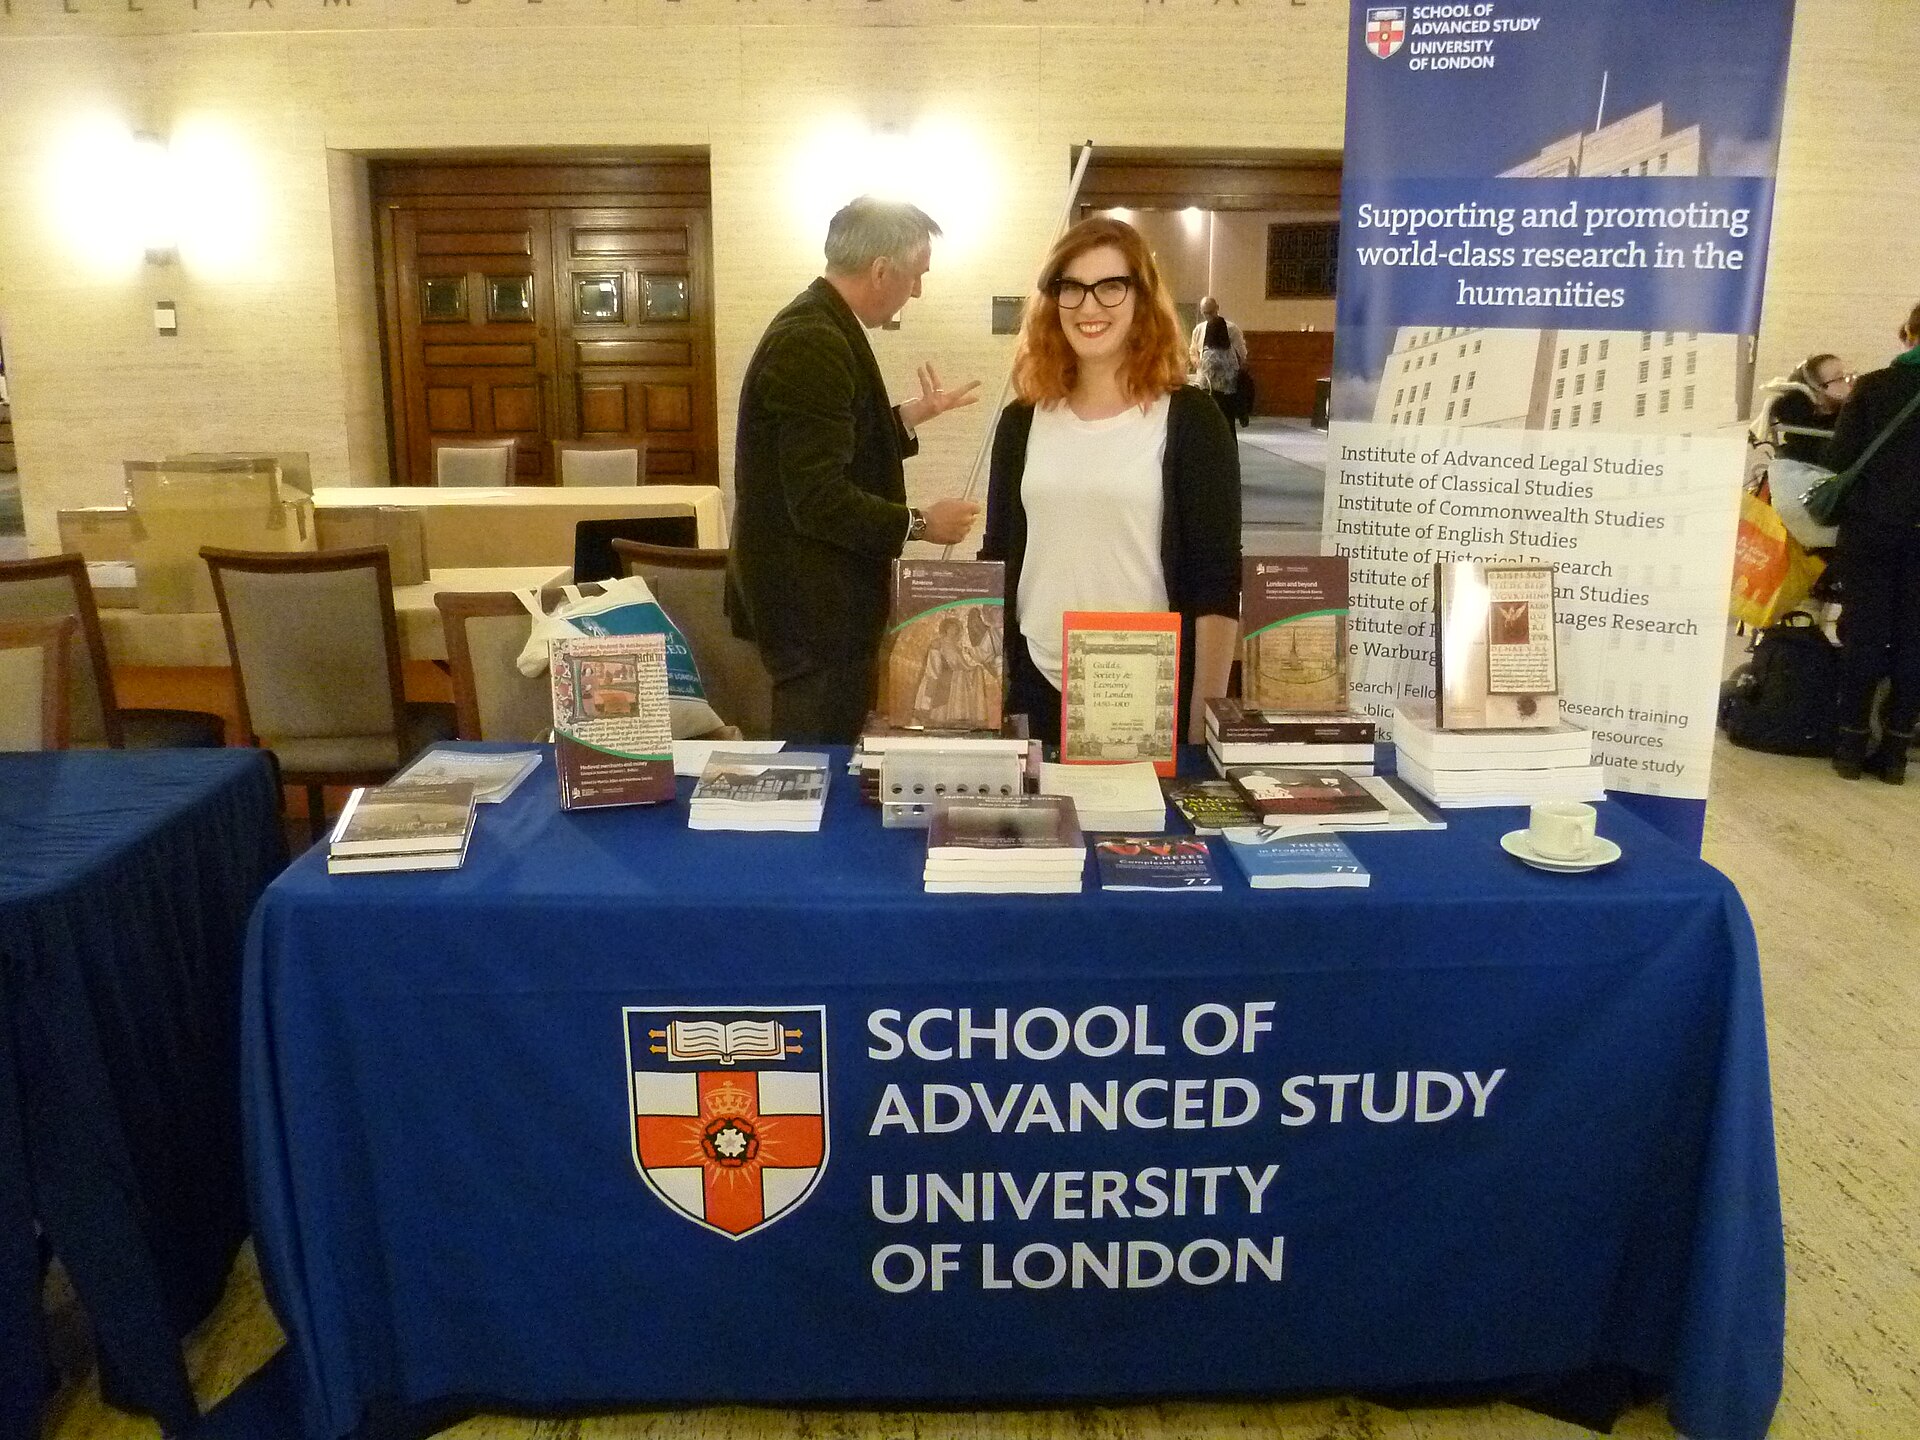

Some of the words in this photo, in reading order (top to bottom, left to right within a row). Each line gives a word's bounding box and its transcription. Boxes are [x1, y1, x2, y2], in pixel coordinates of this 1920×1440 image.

[1412, 4, 1472, 19] SCHOOL
[1473, 4, 1495, 17] OF
[1411, 21, 1491, 35] ADVANCED
[1493, 18, 1541, 32] STUDY
[1410, 40, 1494, 55] UNIVERSITY
[1409, 58, 1429, 71] OF
[1431, 56, 1495, 70] LONDON
[1357, 203, 1515, 236] Supporting
[1522, 200, 1579, 229] and
[1584, 202, 1750, 237] promoting
[1356, 241, 1516, 267] world-class
[1522, 241, 1648, 269] research
[1653, 241, 1685, 270] in
[1692, 242, 1744, 270] the
[1456, 279, 1626, 308] humanities
[1341, 445, 1416, 465] Institute
[1420, 450, 1440, 465] of
[1443, 450, 1535, 471] Advanced
[1539, 455, 1588, 476] Legal
[1592, 457, 1664, 477] Studies
[1339, 470, 1414, 489] Institute
[1418, 474, 1438, 491] of
[1441, 475, 1520, 496] Classical
[1524, 480, 1594, 499] Studies
[1338, 494, 1413, 514] Institute
[1417, 498, 1436, 516] of
[1439, 499, 1589, 525] Commonwealth
[1594, 510, 1666, 530] Studies
[1336, 519, 1411, 539] Institute
[1414, 523, 1436, 540] of
[1437, 524, 1505, 546] English
[1509, 530, 1578, 549] Studies
[1335, 543, 1409, 563] Institute
[1413, 549, 1432, 563] of
[1298, 581, 1317, 589] beyond
[1350, 569, 1406, 587] stitute
[1411, 572, 1431, 588] of
[1348, 593, 1405, 611] stitute
[1409, 597, 1429, 613] of
[1580, 588, 1650, 607] Studies
[1407, 621, 1427, 637] of
[1552, 612, 1607, 629] uages
[1610, 614, 1699, 637] Research
[1558, 699, 1624, 719] Research
[1628, 708, 1689, 729] training
[1591, 729, 1664, 748] resources
[1641, 760, 1686, 777] study
[867, 1004, 1166, 1061] SCHOOL
[1182, 1001, 1276, 1056] OF
[868, 1075, 1261, 1136] ADVANCED
[1280, 1068, 1506, 1127] STUDY
[871, 1164, 1280, 1224] UNIVERSITY
[871, 1243, 962, 1293] OF
[982, 1236, 1285, 1289] LONDON
